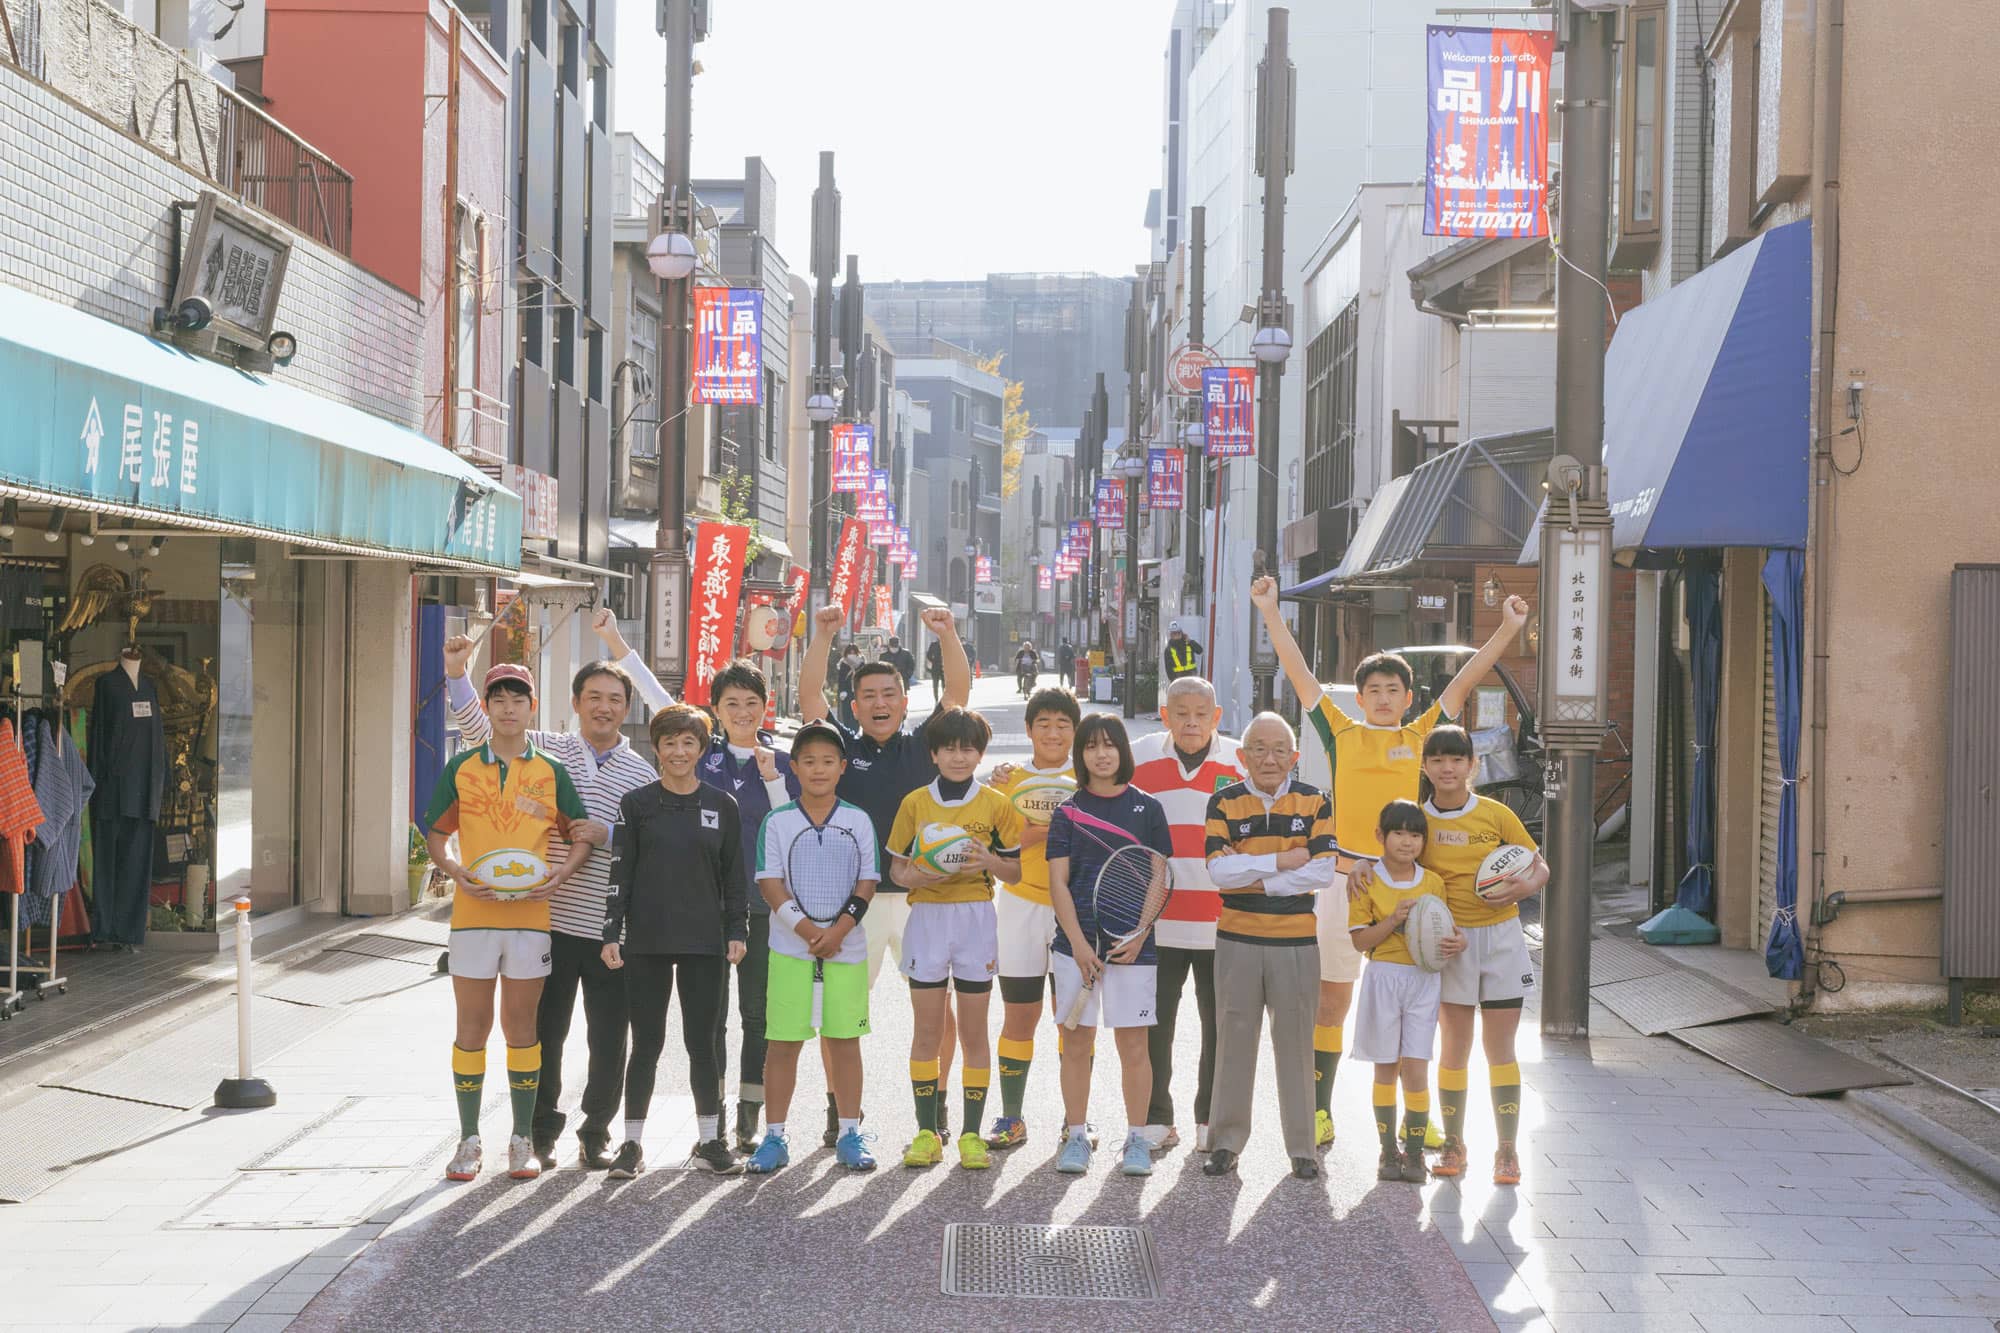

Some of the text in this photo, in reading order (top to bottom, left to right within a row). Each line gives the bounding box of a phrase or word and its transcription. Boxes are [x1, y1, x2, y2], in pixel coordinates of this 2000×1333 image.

[1443, 51, 1536, 64] Welcome to our city
[1437, 69, 1541, 113] 品川
[1459, 116, 1519, 125] SHINAGAWA
[1207, 383, 1251, 403] 品川
[119, 403, 199, 495] 尾張屋
[1151, 459, 1181, 472] 品川
[696, 533, 732, 687] 東海七福神
[1568, 571, 1585, 680] 北品川商店街
